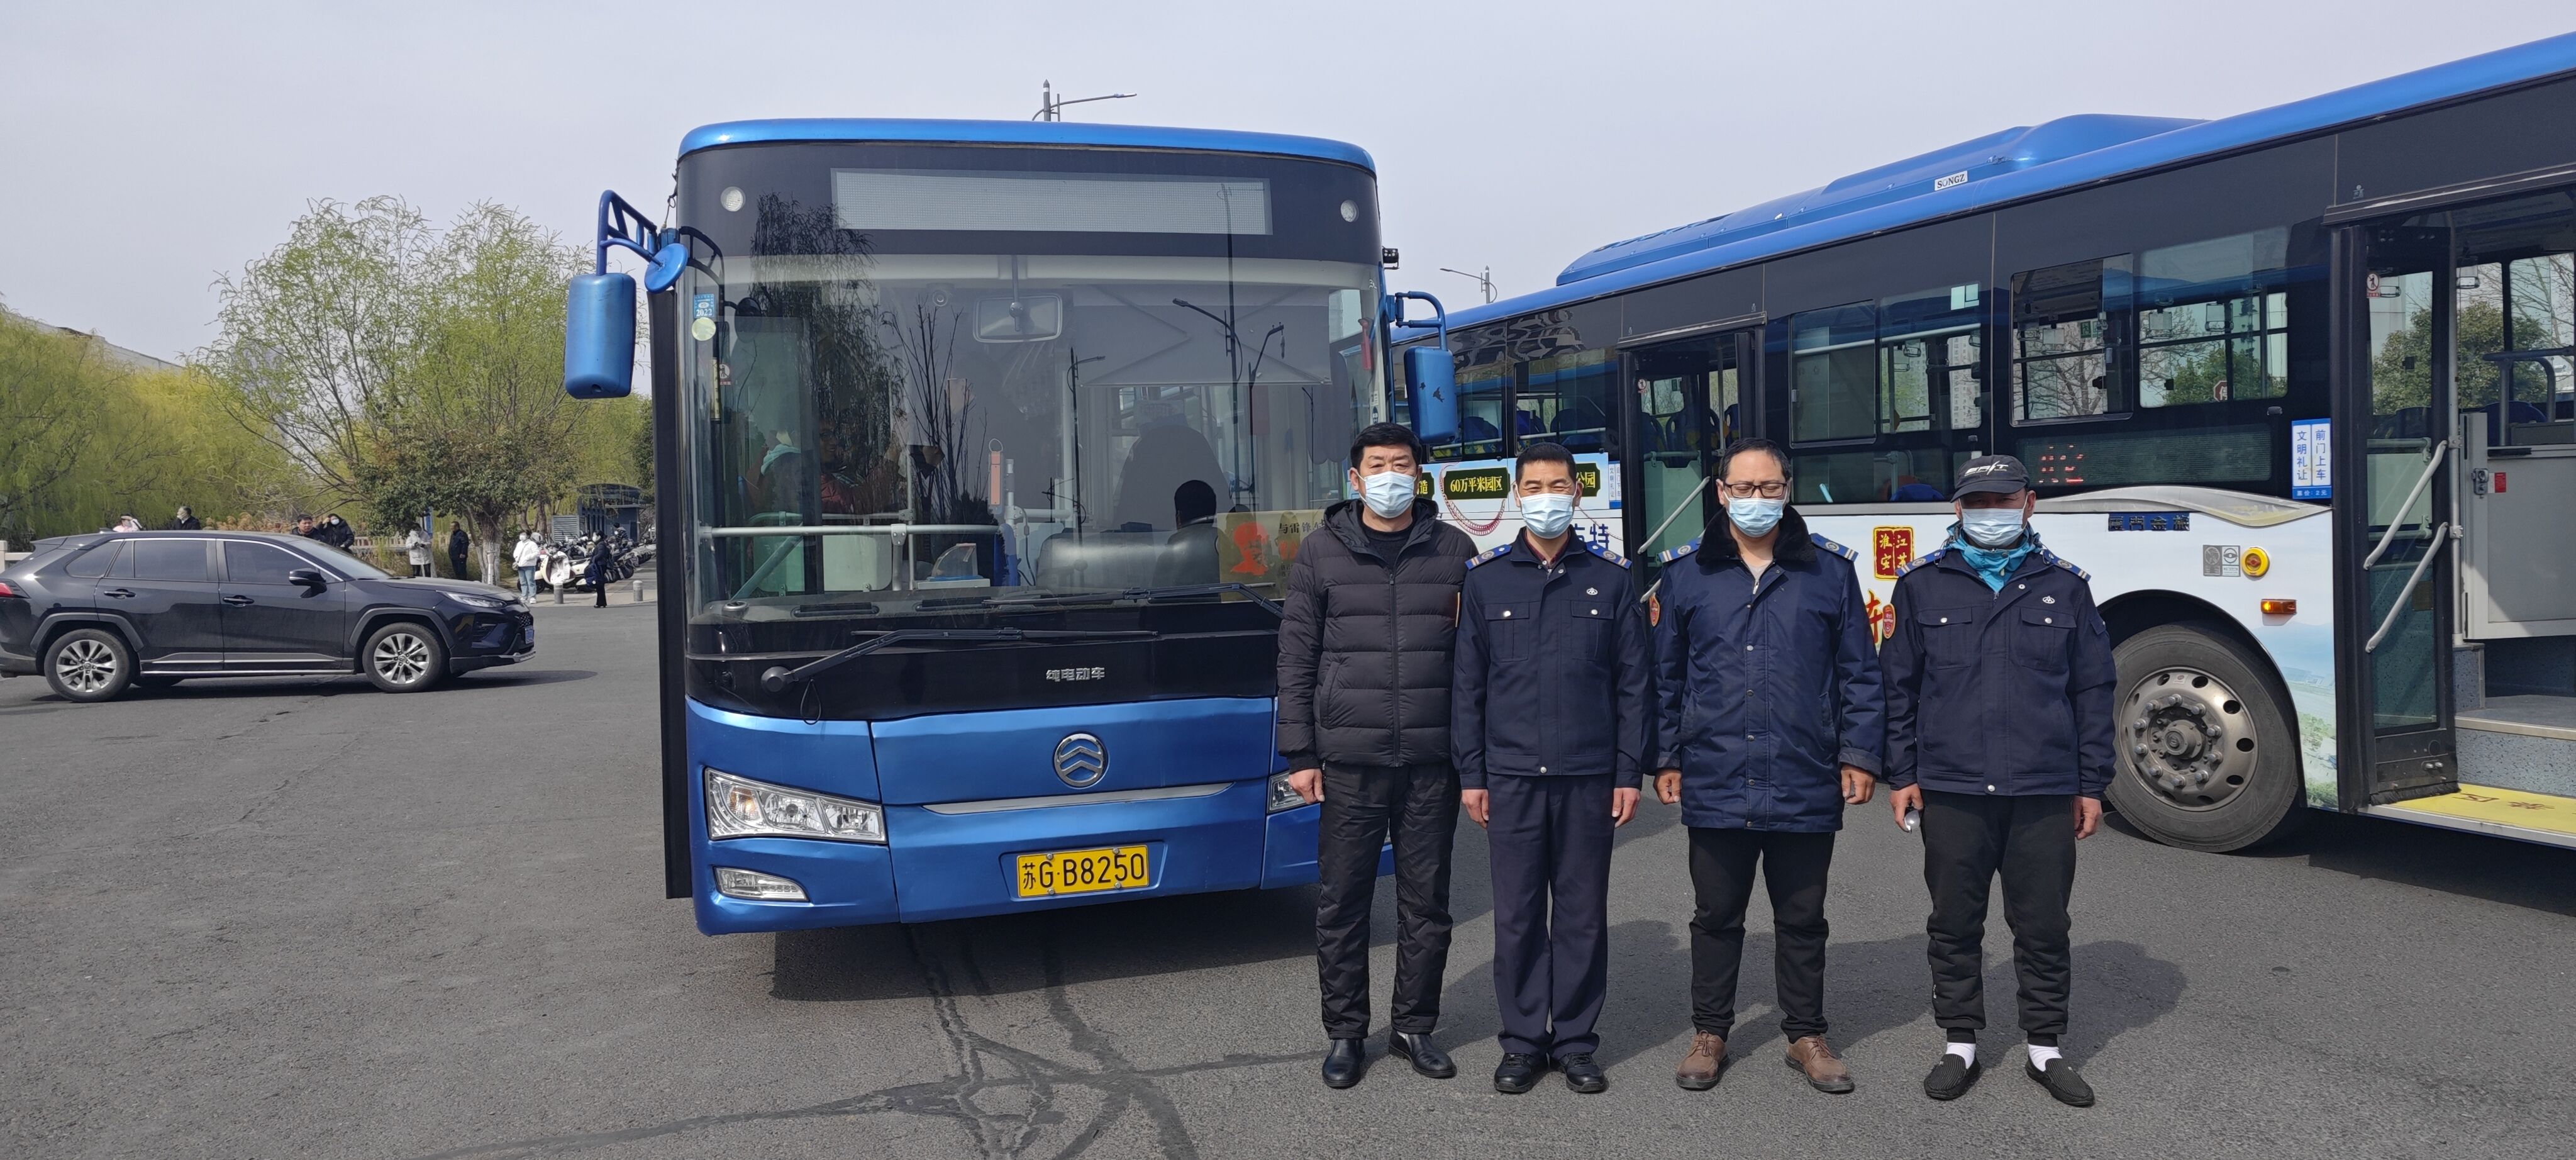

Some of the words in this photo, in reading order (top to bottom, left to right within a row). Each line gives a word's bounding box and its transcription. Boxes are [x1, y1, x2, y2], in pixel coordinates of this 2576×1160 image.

[1937, 174, 1965, 189] SONGZ
[696, 308, 713, 317] 2022
[2297, 431, 2307, 481] 文明礼让
[2316, 429, 2326, 480] 前门上车
[1450, 476, 1502, 493] 60万平米园区
[1046, 667, 1105, 682] 纯电动车
